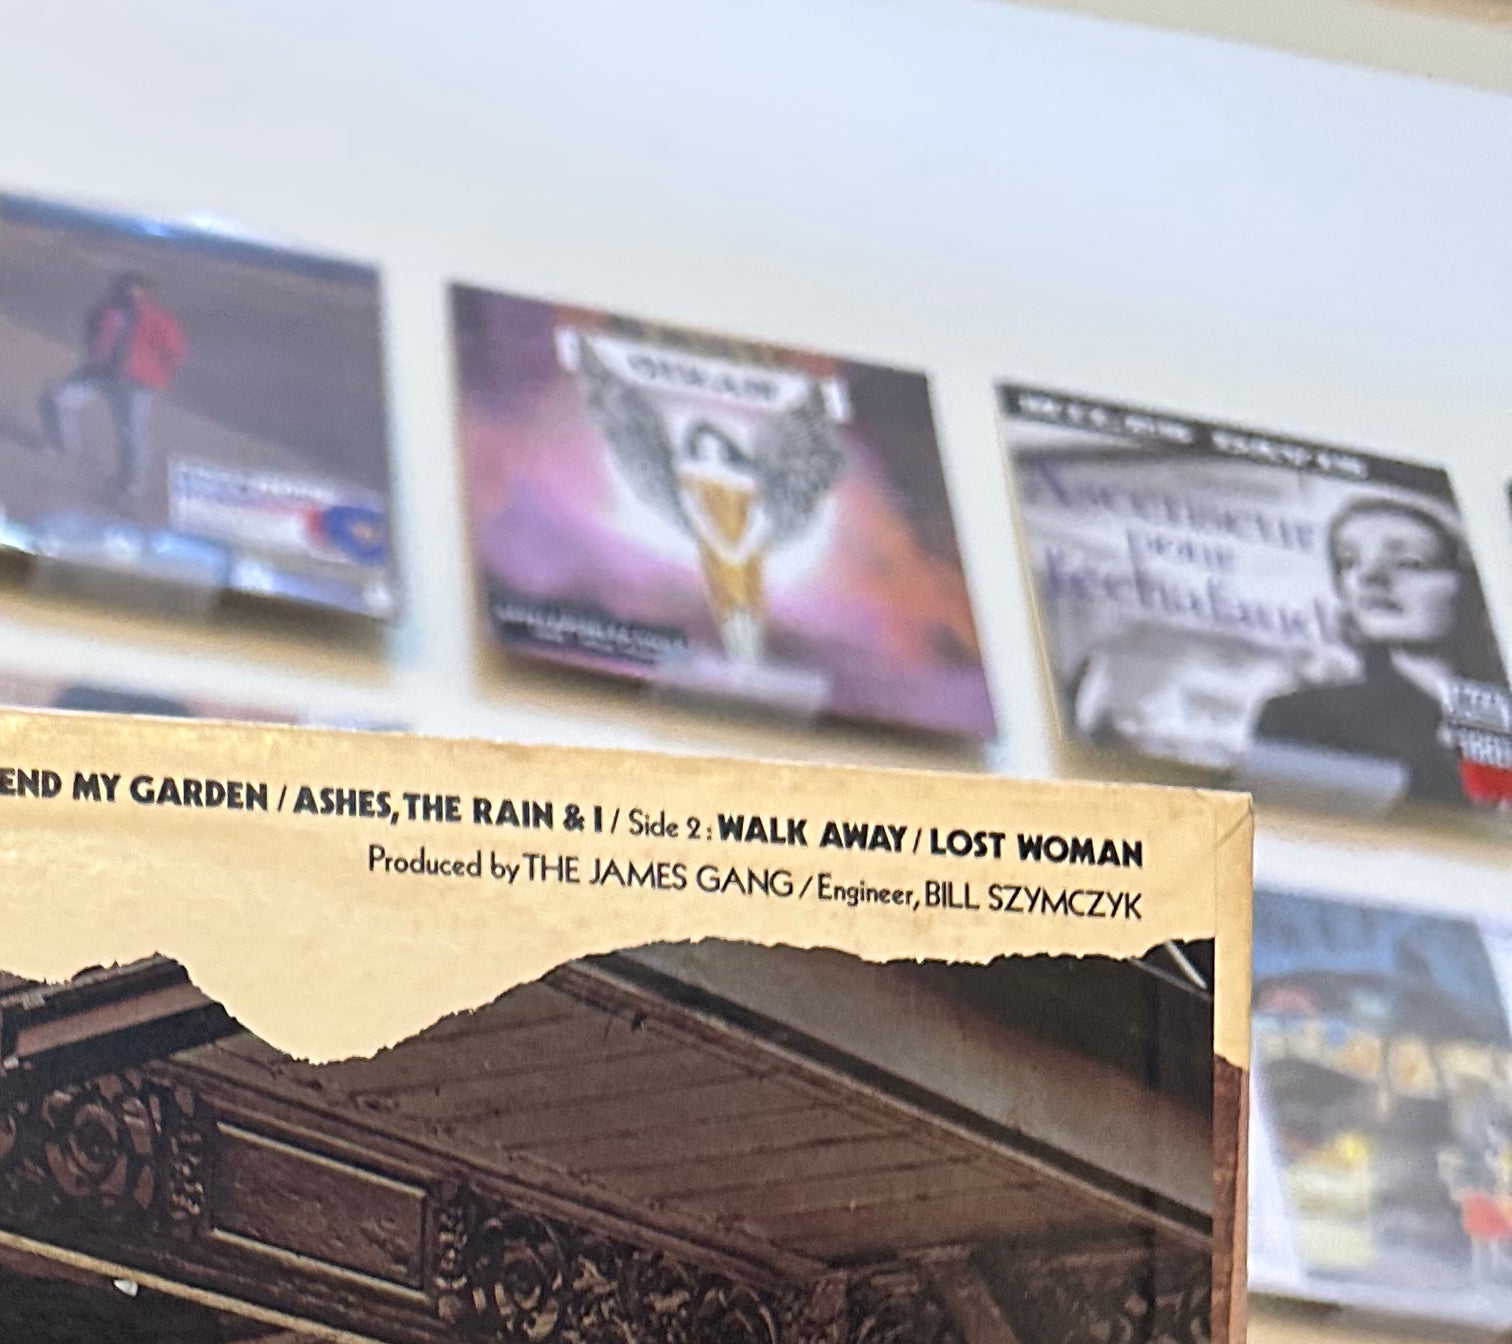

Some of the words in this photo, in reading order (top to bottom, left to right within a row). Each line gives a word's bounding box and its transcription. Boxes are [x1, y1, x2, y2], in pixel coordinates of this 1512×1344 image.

[72, 770, 122, 803] MY
[129, 774, 268, 813] GARDEN
[292, 785, 399, 826] ASHES,
[403, 791, 462, 824] THE
[472, 796, 554, 830] RAIN
[562, 802, 586, 833] &
[593, 804, 603, 833] I
[628, 807, 679, 840] Side
[717, 813, 808, 848] WALK
[818, 820, 908, 855] AWAY
[930, 827, 1007, 860] LOST
[1016, 832, 1143, 870] WOMAN
[368, 843, 482, 879] Produced
[490, 850, 520, 885] by
[524, 853, 581, 884] THE
[588, 857, 688, 892] JAMES
[695, 864, 794, 899] GANG
[817, 872, 920, 913] Engineer,
[925, 880, 981, 911] BILL
[988, 883, 1143, 921] SZYMCZYK
